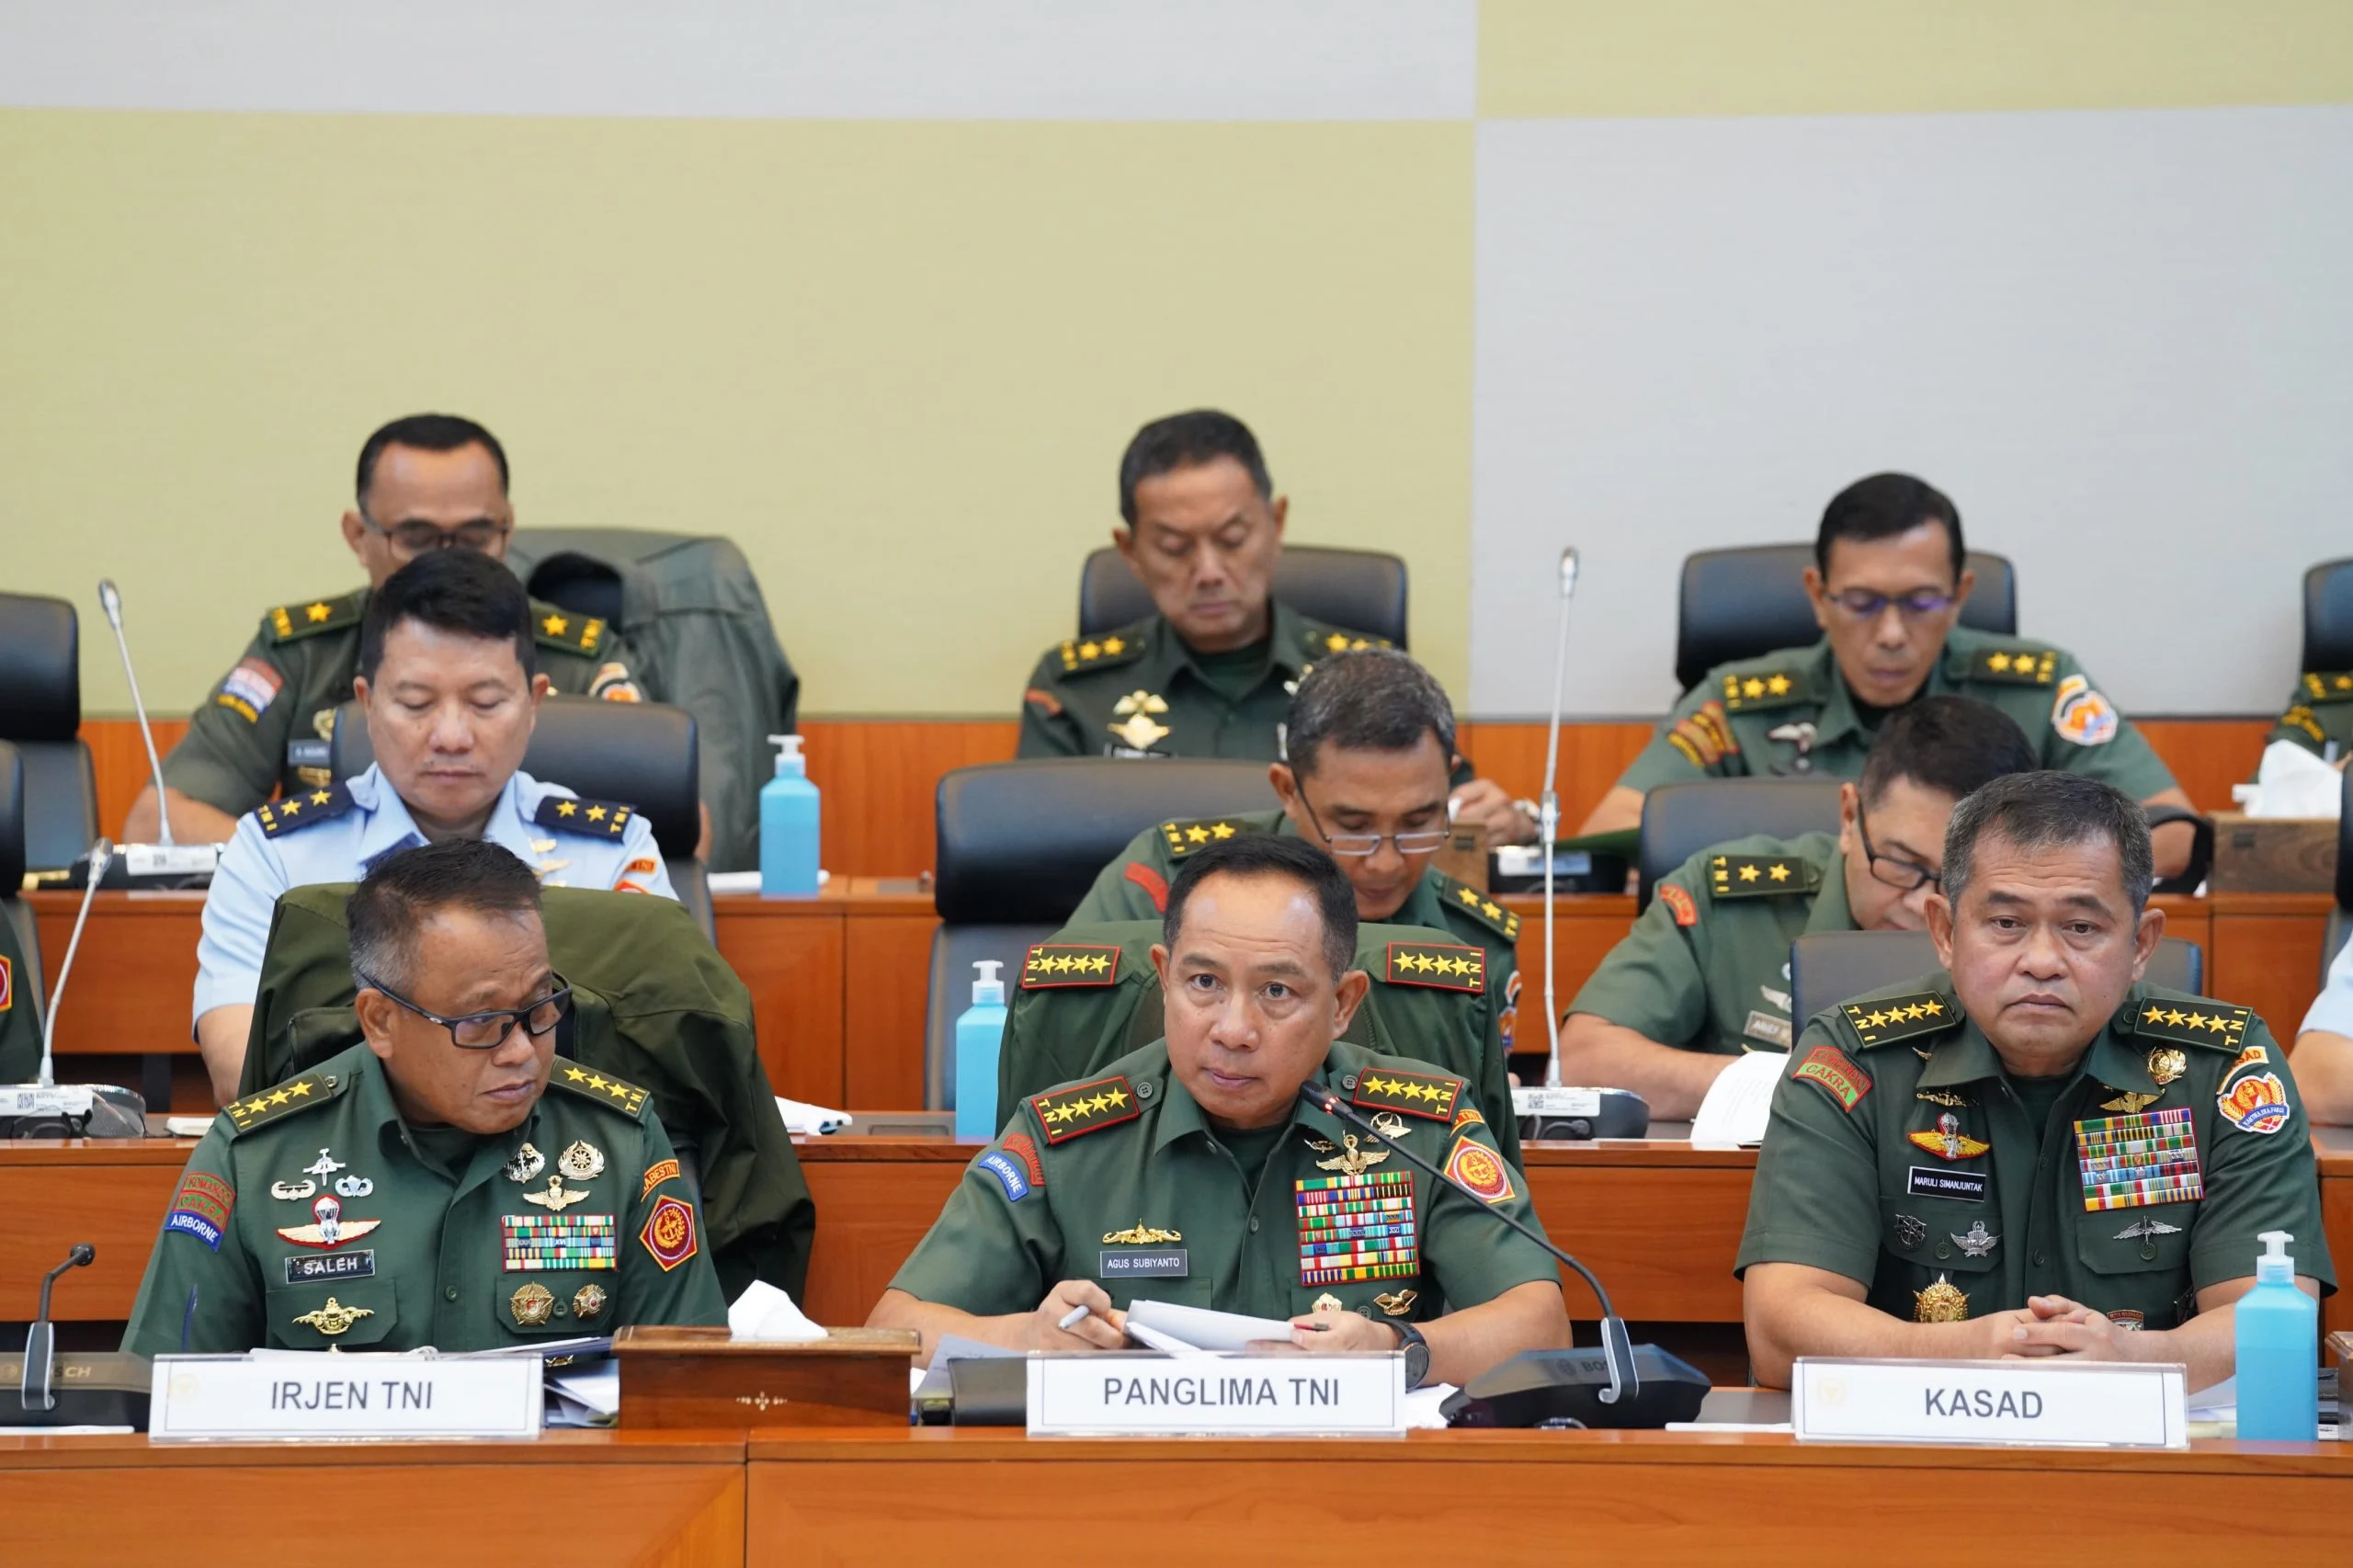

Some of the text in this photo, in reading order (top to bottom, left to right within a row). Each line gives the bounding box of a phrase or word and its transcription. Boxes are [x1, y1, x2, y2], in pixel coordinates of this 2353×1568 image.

[610, 806, 631, 834] TNI
[1712, 856, 1730, 892] TNI
[1025, 948, 1043, 982] TNI
[1469, 951, 1482, 987] TNI
[1847, 1006, 1876, 1041] TNI
[2224, 1009, 2248, 1046] TNI
[1806, 1064, 1852, 1099] CAKRA
[625, 1087, 647, 1111] TNI
[1436, 1082, 1457, 1114] TNI
[229, 1101, 252, 1127] TNI
[1038, 1097, 1063, 1136] TNI
[985, 1155, 1022, 1193] AIRBORNE
[1915, 1176, 1983, 1192] MARULI SIMANJUNTAK
[181, 1196, 224, 1223] CAKRA
[170, 1214, 219, 1243] AIRBORNE
[303, 1256, 358, 1275] SALEH
[1108, 1257, 1180, 1269] AGUS SUBIYANTO
[271, 1381, 432, 1410] IRJEN TNI
[1104, 1378, 1338, 1406] PANGLIMA TNI
[1926, 1388, 2043, 1419] KASAD
